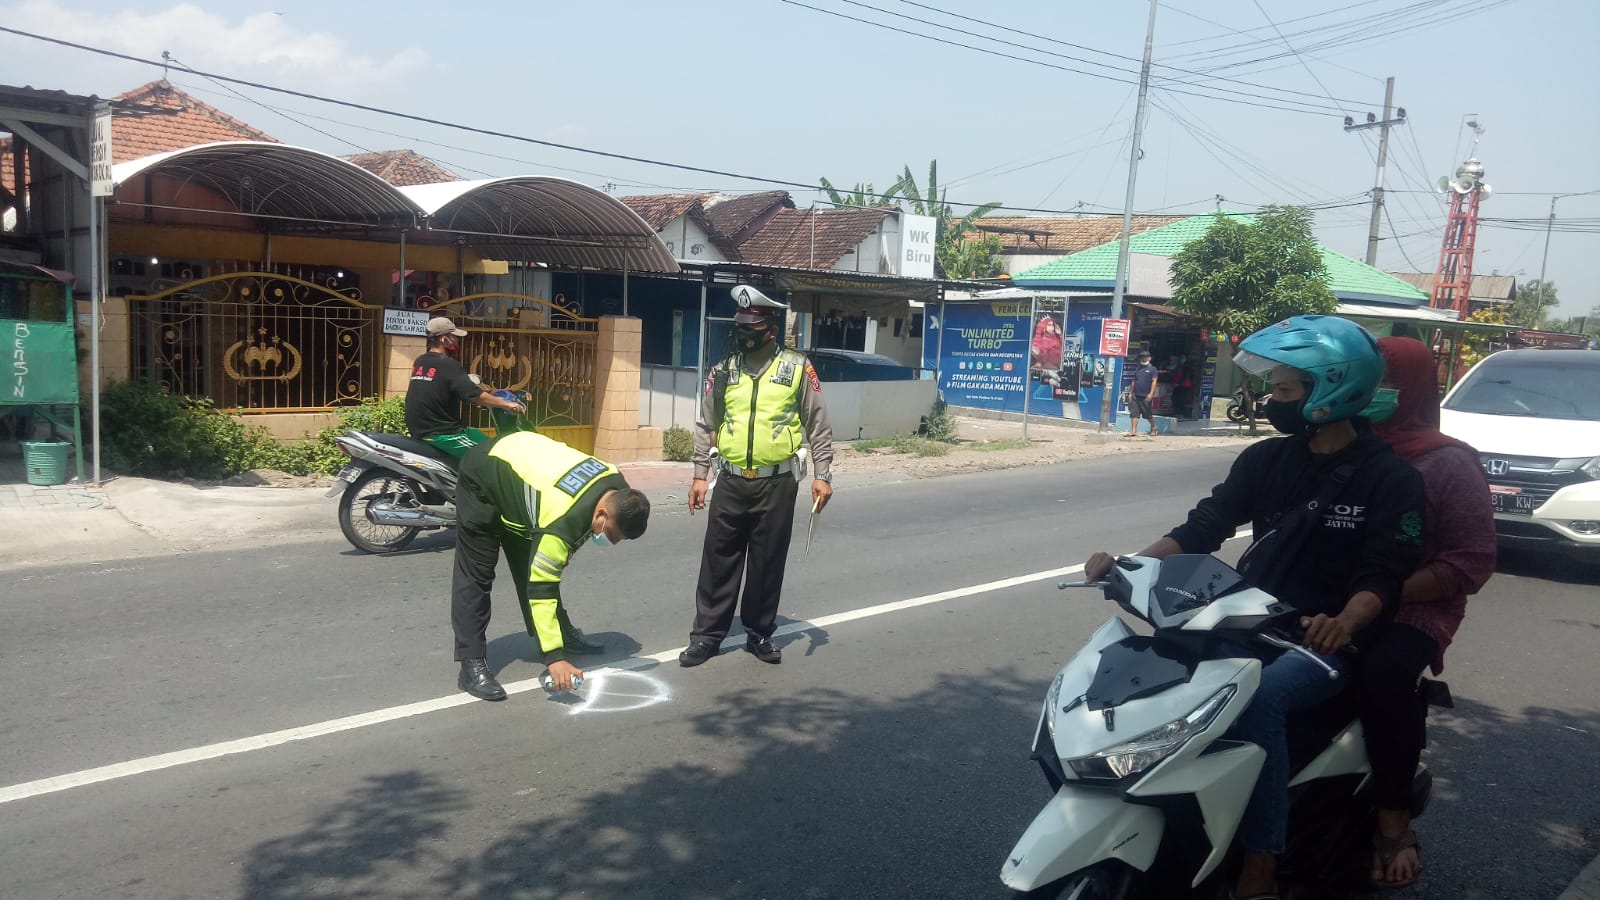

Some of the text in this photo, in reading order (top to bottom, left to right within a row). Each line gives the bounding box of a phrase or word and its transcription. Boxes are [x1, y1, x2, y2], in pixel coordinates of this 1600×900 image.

[910, 230, 930, 243] WK
[906, 249, 931, 263] Biru
[961, 328, 1015, 339] UNLIMITED
[968, 338, 1002, 349] TURBO
[952, 374, 1023, 384] STREAMING YOUTUBE
[980, 383, 994, 391] ADA
[994, 384, 1024, 392] MATINYA
[559, 459, 606, 494] POLISI
[1515, 496, 1532, 509] KW
[1325, 520, 1355, 529] JATIM
[1165, 586, 1197, 600] HONDA
